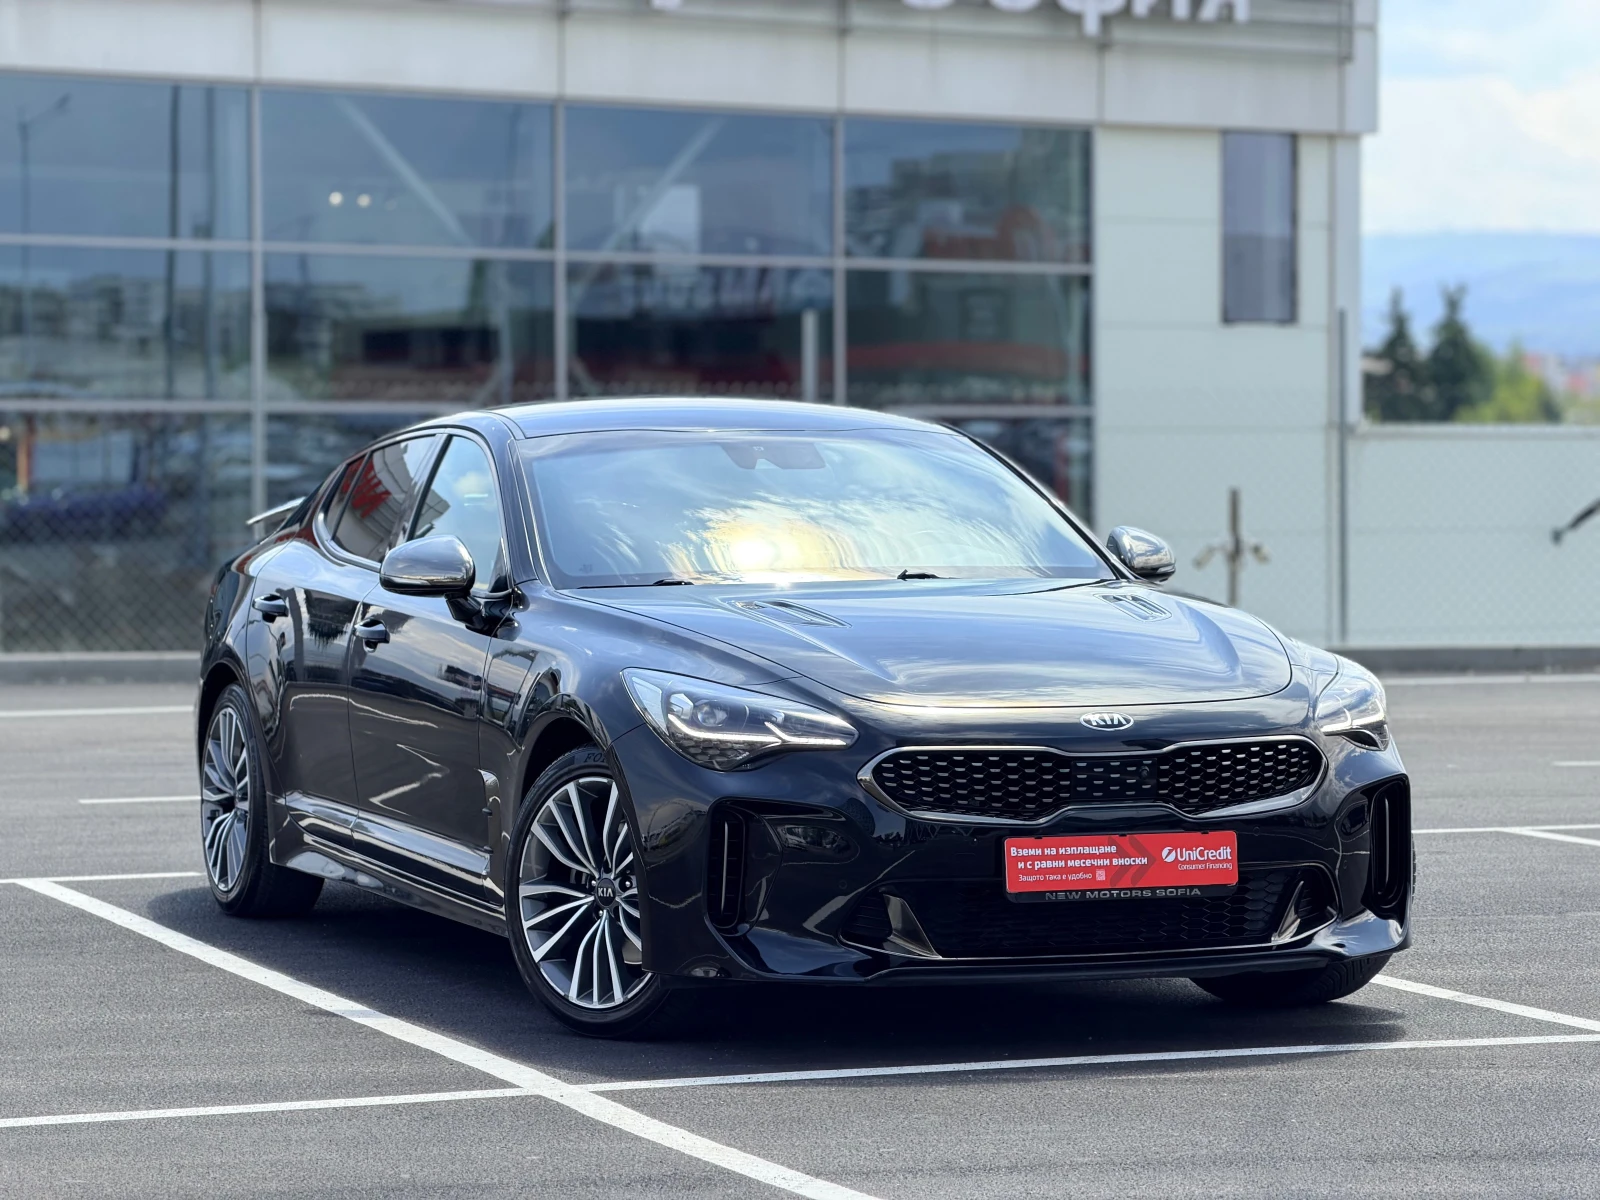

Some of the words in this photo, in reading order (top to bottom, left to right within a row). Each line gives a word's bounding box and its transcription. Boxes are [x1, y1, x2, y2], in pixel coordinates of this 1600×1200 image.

[1083, 712, 1128, 726] KIA
[583, 752, 605, 763] FO
[1010, 846, 1042, 857] Вземи
[1044, 847, 1057, 855] на
[1058, 845, 1117, 855] изплащане
[1177, 846, 1232, 861] UniCredit
[1017, 861, 1025, 869] и
[1026, 861, 1033, 869] с
[1034, 859, 1065, 870] равни
[1067, 858, 1110, 868] месечни
[1112, 856, 1148, 866] вноски
[1206, 862, 1233, 870] Financing
[1018, 874, 1044, 882] Защото
[1045, 873, 1061, 881] така
[1067, 871, 1092, 881] удобно
[597, 887, 614, 897] KIA
[1045, 891, 1081, 900] NEW
[1086, 889, 1151, 899] MOTORS
[1156, 888, 1201, 896] SOFIA
